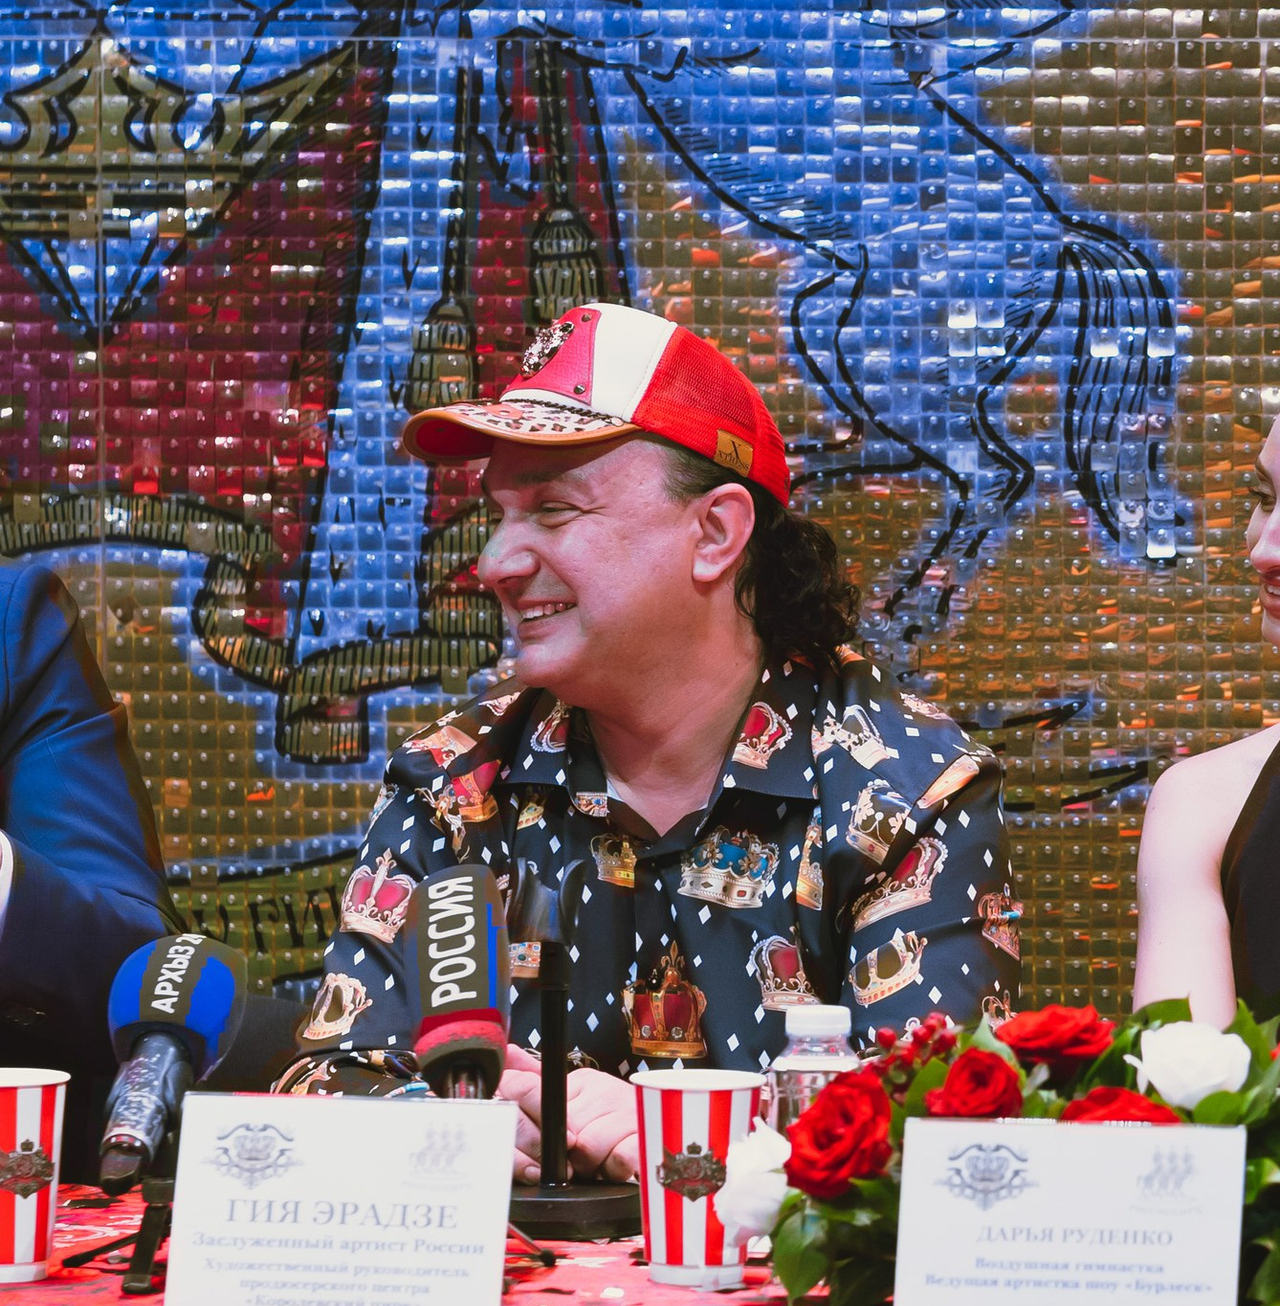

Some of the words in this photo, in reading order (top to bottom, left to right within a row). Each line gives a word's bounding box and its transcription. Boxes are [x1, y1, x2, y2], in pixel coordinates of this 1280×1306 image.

[428, 876, 477, 1008] РОССИЯ
[151, 945, 196, 1014] АРХЫЗ
[226, 1198, 302, 1224] ГИЯ
[312, 1201, 459, 1231] ЭРАДЗЕ
[192, 1231, 333, 1251] Заслуженный
[339, 1238, 407, 1253] артист
[413, 1238, 485, 1255] России
[976, 1225, 1055, 1244] ДАРЬЯ
[1062, 1227, 1173, 1246] РУДЕНКО
[203, 1257, 348, 1275] Художественный
[353, 1263, 470, 1278] руководитель
[239, 1277, 367, 1293] продюсерского
[372, 1282, 430, 1296] центра
[925, 1273, 999, 1289] Ведущая
[1004, 1279, 1080, 1293] артистка
[1085, 1279, 1118, 1293] шоу
